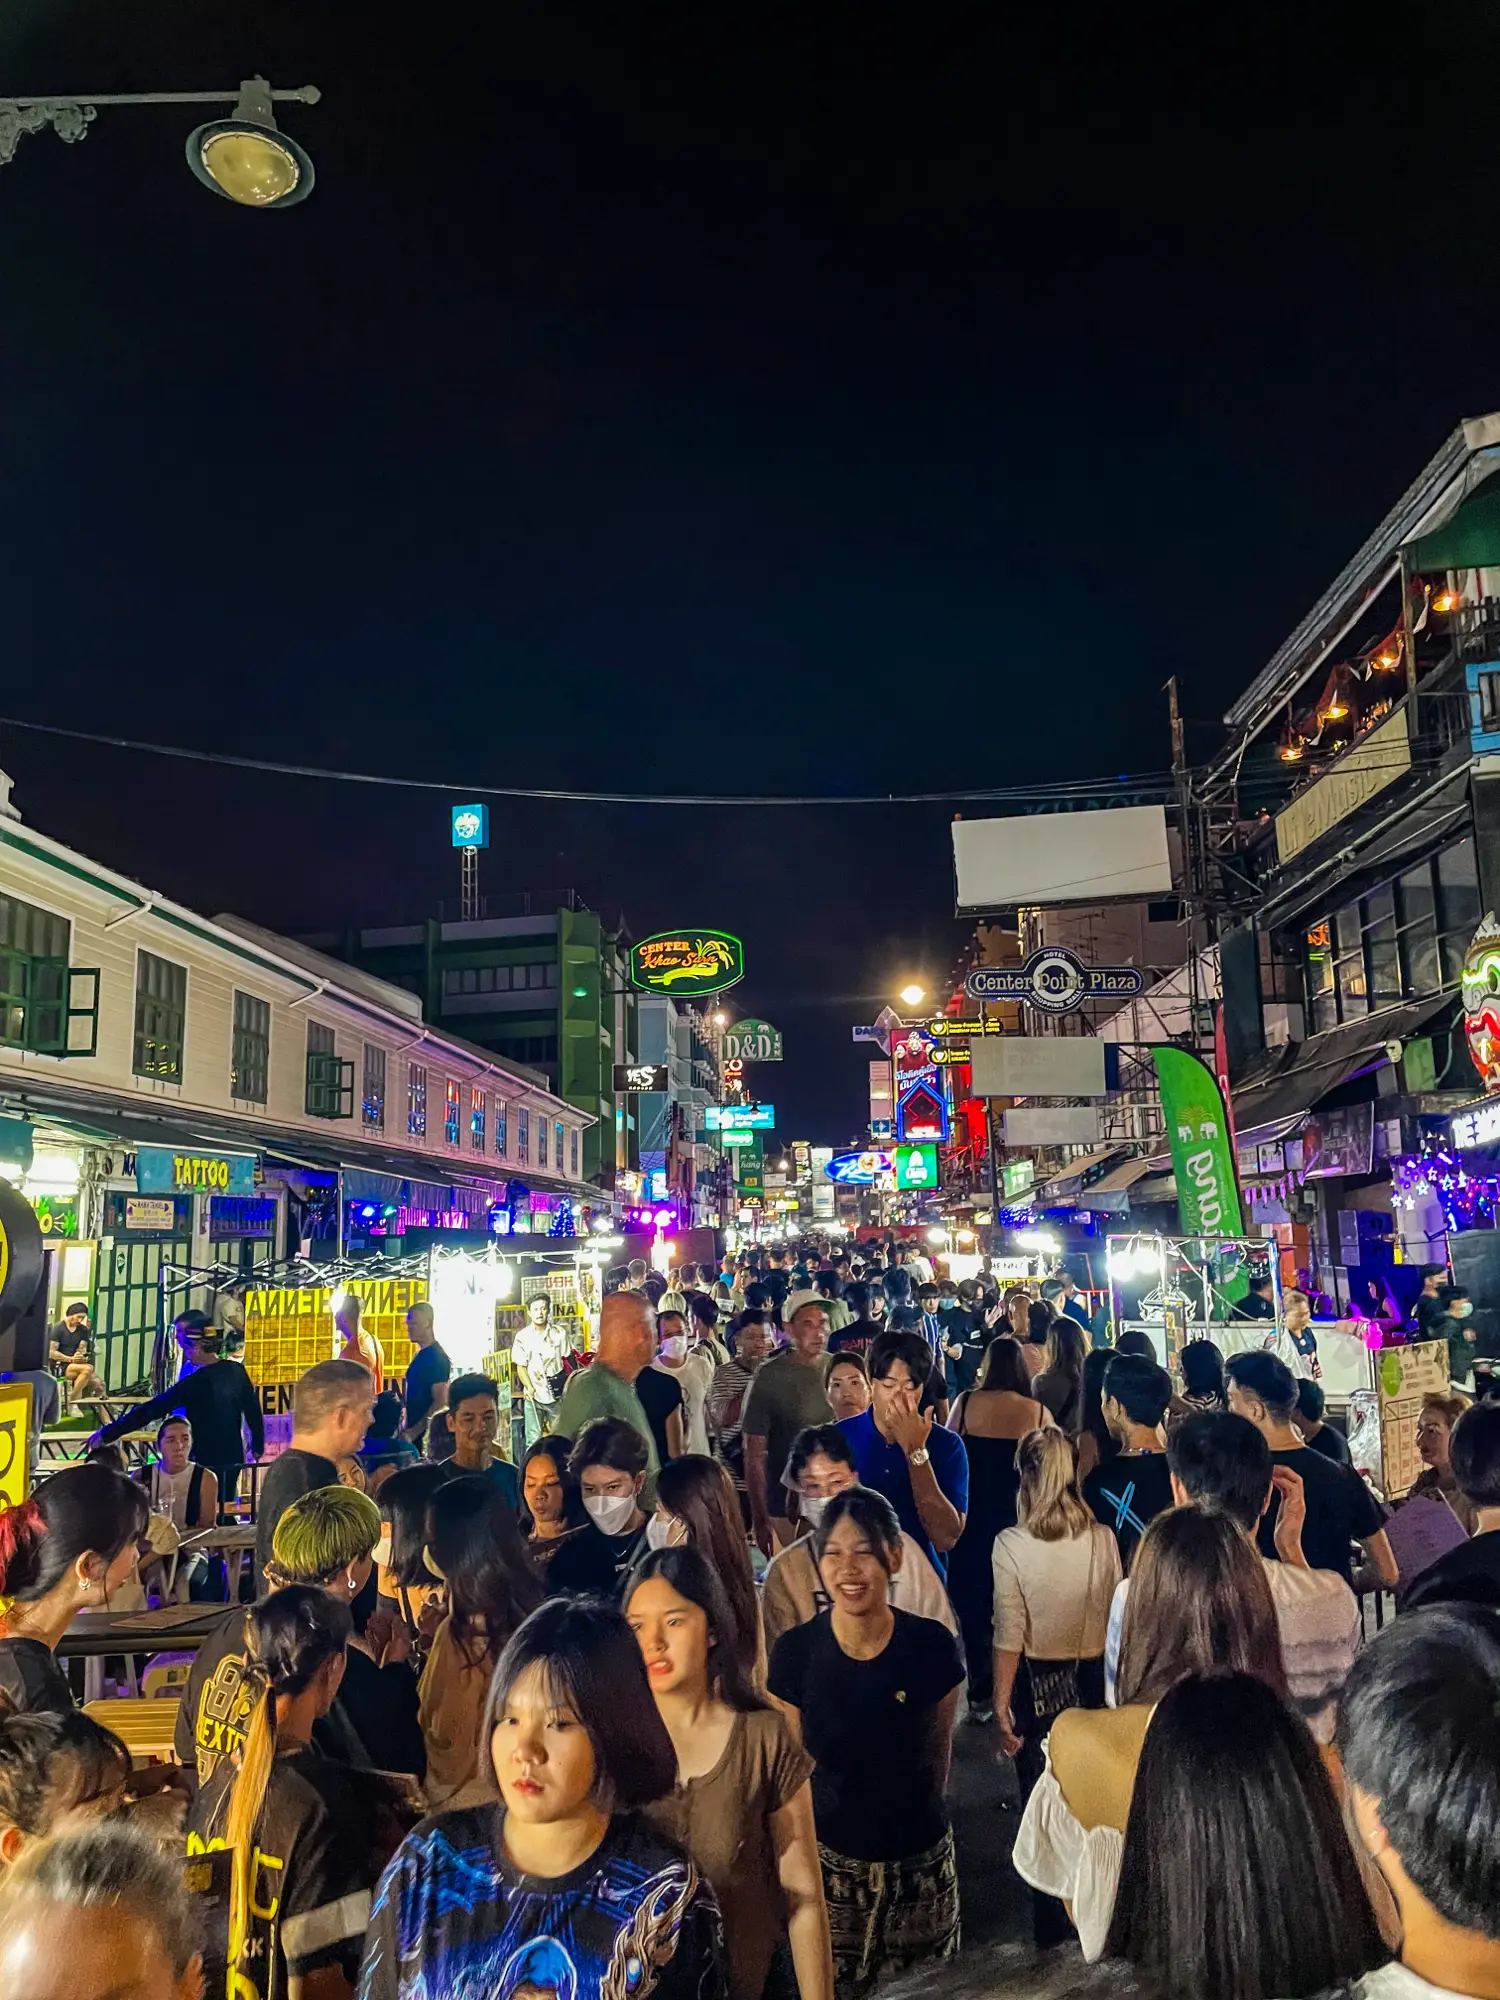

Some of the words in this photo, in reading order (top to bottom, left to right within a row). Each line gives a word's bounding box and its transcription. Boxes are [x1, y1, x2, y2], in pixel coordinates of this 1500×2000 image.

[639, 941, 691, 954] CENTER
[640, 954, 681, 969] Khao
[975, 973, 1034, 991] Center
[1037, 972, 1085, 991] Point
[1090, 972, 1137, 990] Plaza
[1030, 991, 1065, 1008] SHOPPING
[1065, 990, 1082, 1005] MALL
[726, 1034, 771, 1060] D&D
[773, 1034, 781, 1057] INN
[626, 1065, 658, 1087] YES
[174, 1157, 229, 1188] TATTOO
